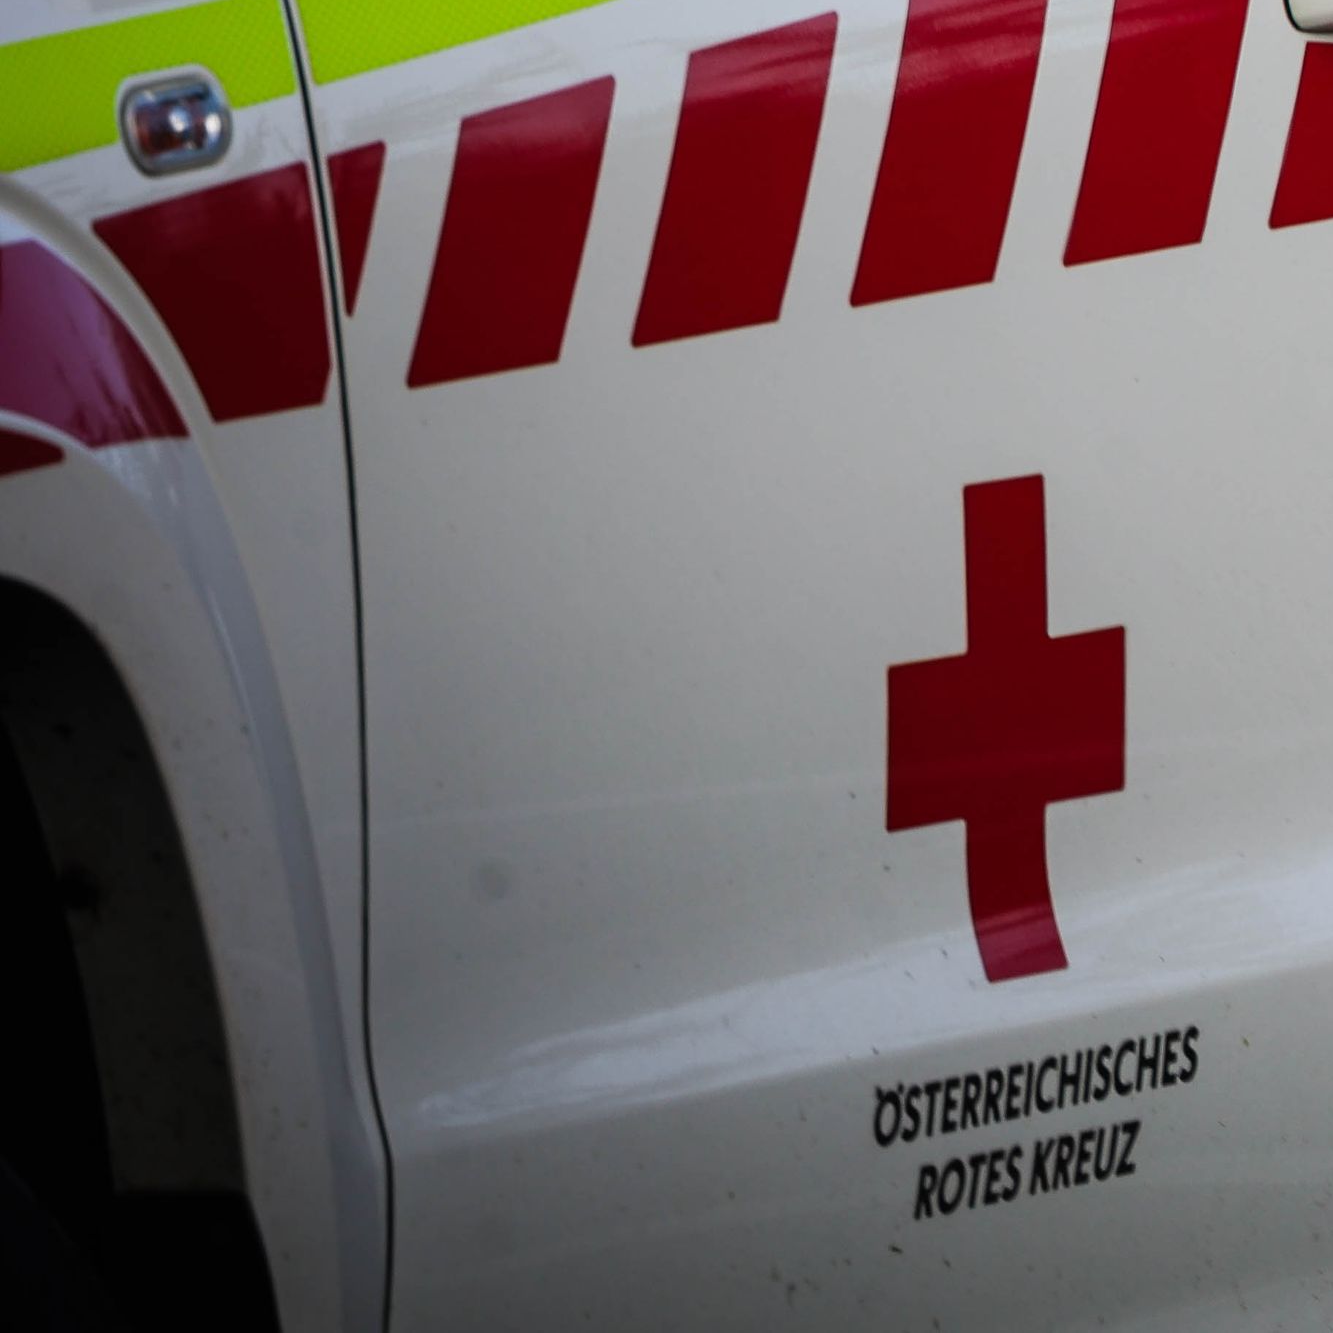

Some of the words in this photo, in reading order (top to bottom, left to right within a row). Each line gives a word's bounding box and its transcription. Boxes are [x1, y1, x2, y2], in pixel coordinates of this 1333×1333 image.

[873, 1025, 1200, 1148] ÖSTERREICHISCHES
[912, 1143, 1024, 1221] ROTES
[1029, 1120, 1142, 1196] KREUZ
